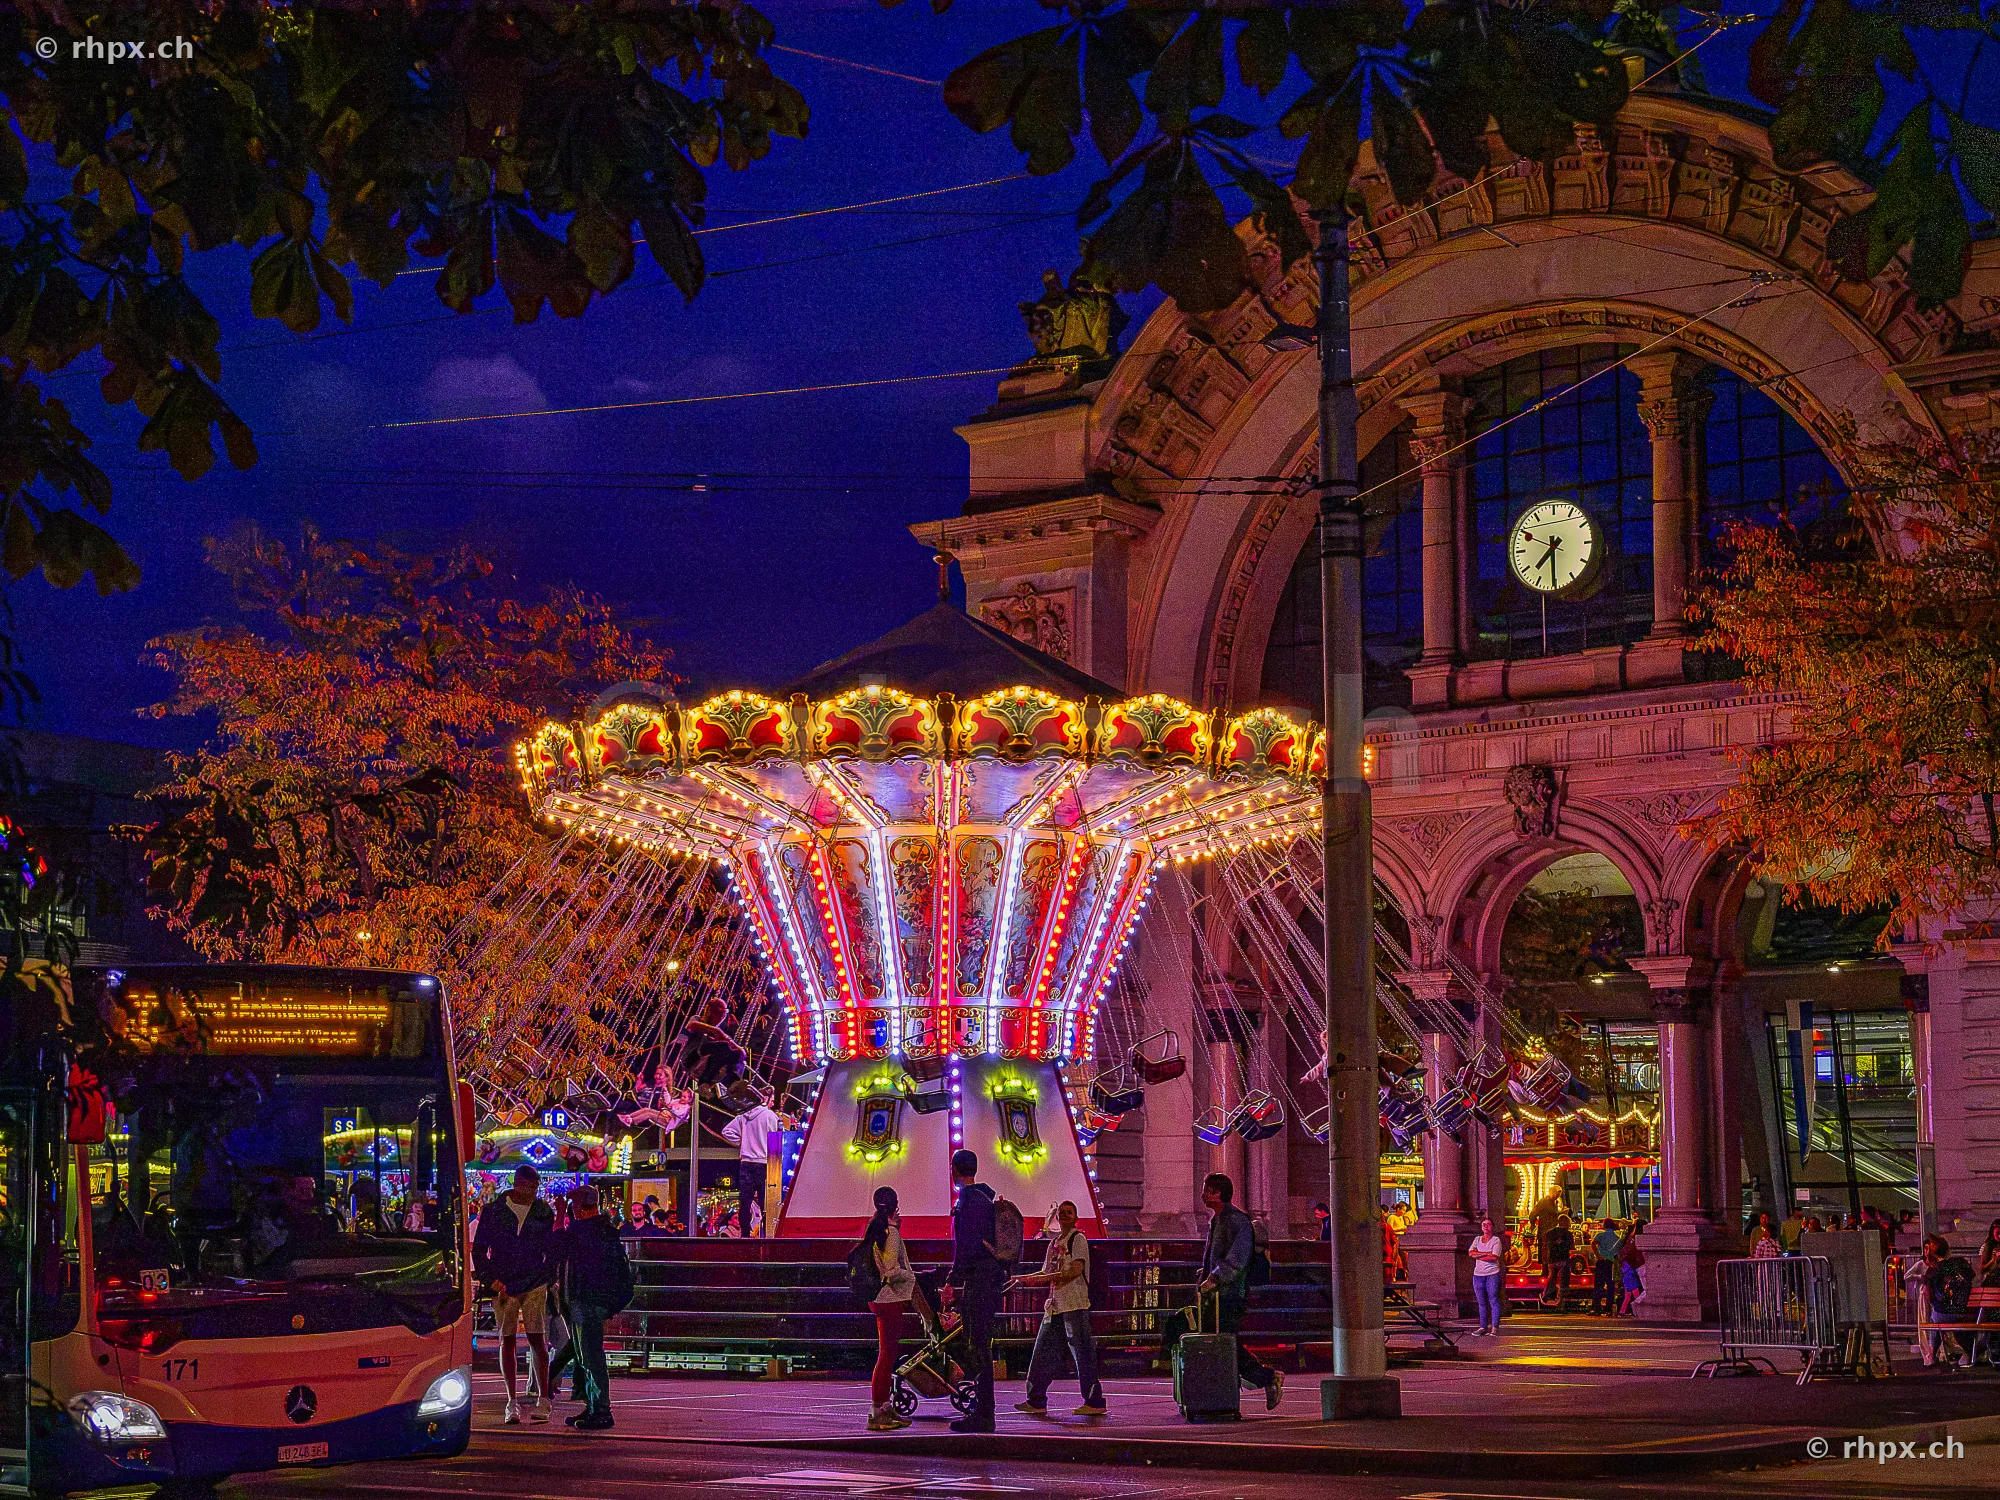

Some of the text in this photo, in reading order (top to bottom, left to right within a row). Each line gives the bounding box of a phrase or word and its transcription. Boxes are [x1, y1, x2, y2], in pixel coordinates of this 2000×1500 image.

[556, 1113, 565, 1126] R
[334, 1120, 354, 1133] S S
[161, 1358, 199, 1381] 171
